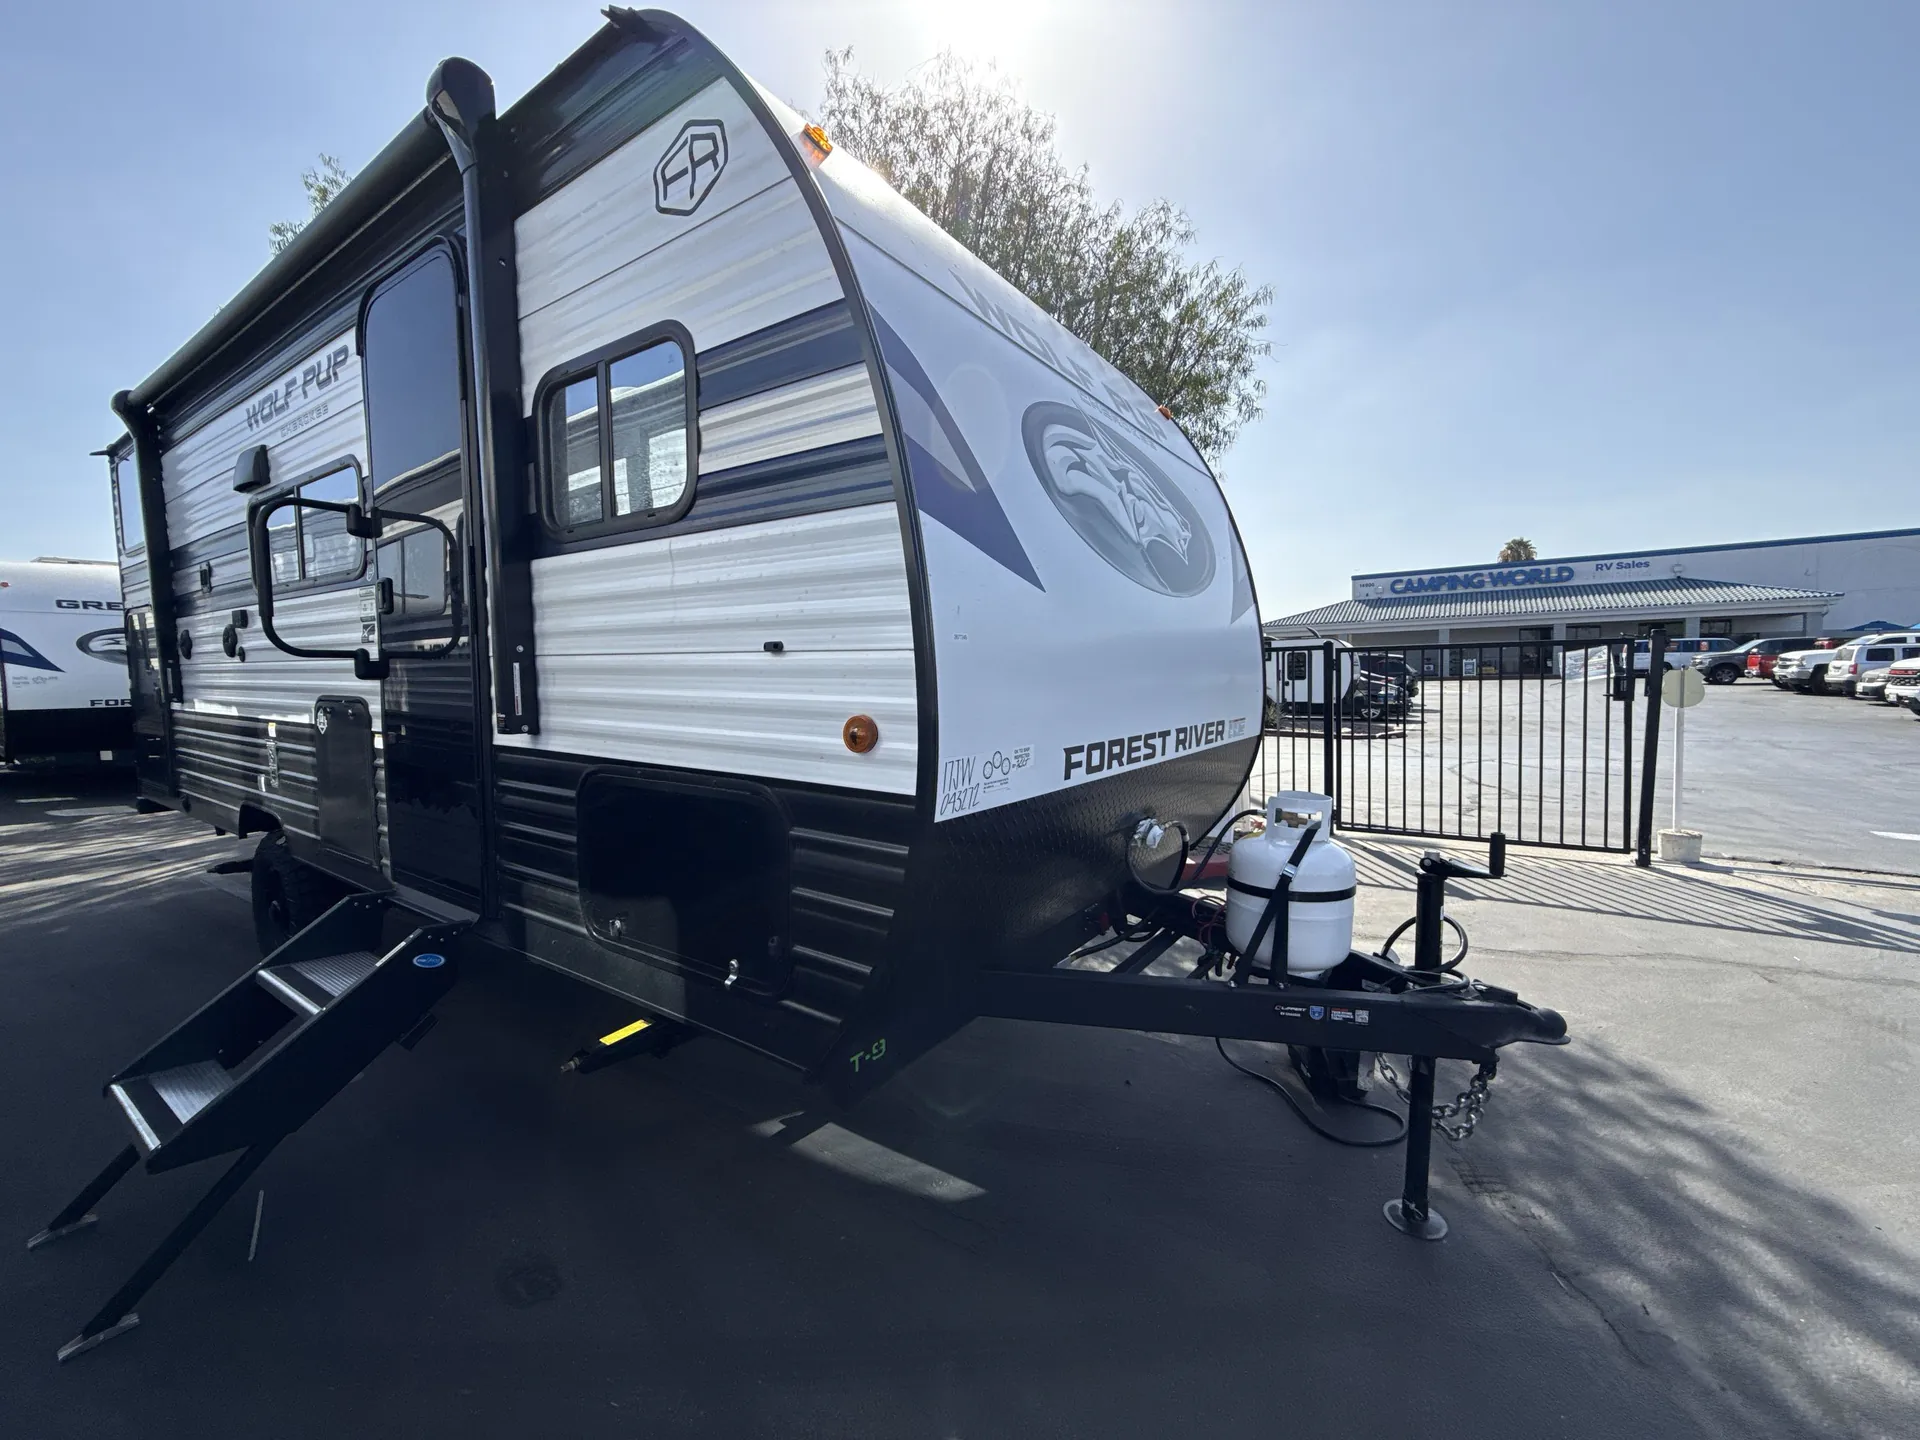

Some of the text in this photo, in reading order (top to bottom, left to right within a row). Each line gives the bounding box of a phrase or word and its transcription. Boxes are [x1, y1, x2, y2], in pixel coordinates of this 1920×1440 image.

[245, 344, 350, 432] WOLF PUP
[280, 400, 329, 438] CHEROKEE
[1389, 571, 1485, 595] CAMPING
[1488, 565, 1575, 588] WORLD
[1595, 560, 1651, 572] RV Sales
[1063, 729, 1171, 781] FOREST
[1174, 719, 1226, 753] RIVER
